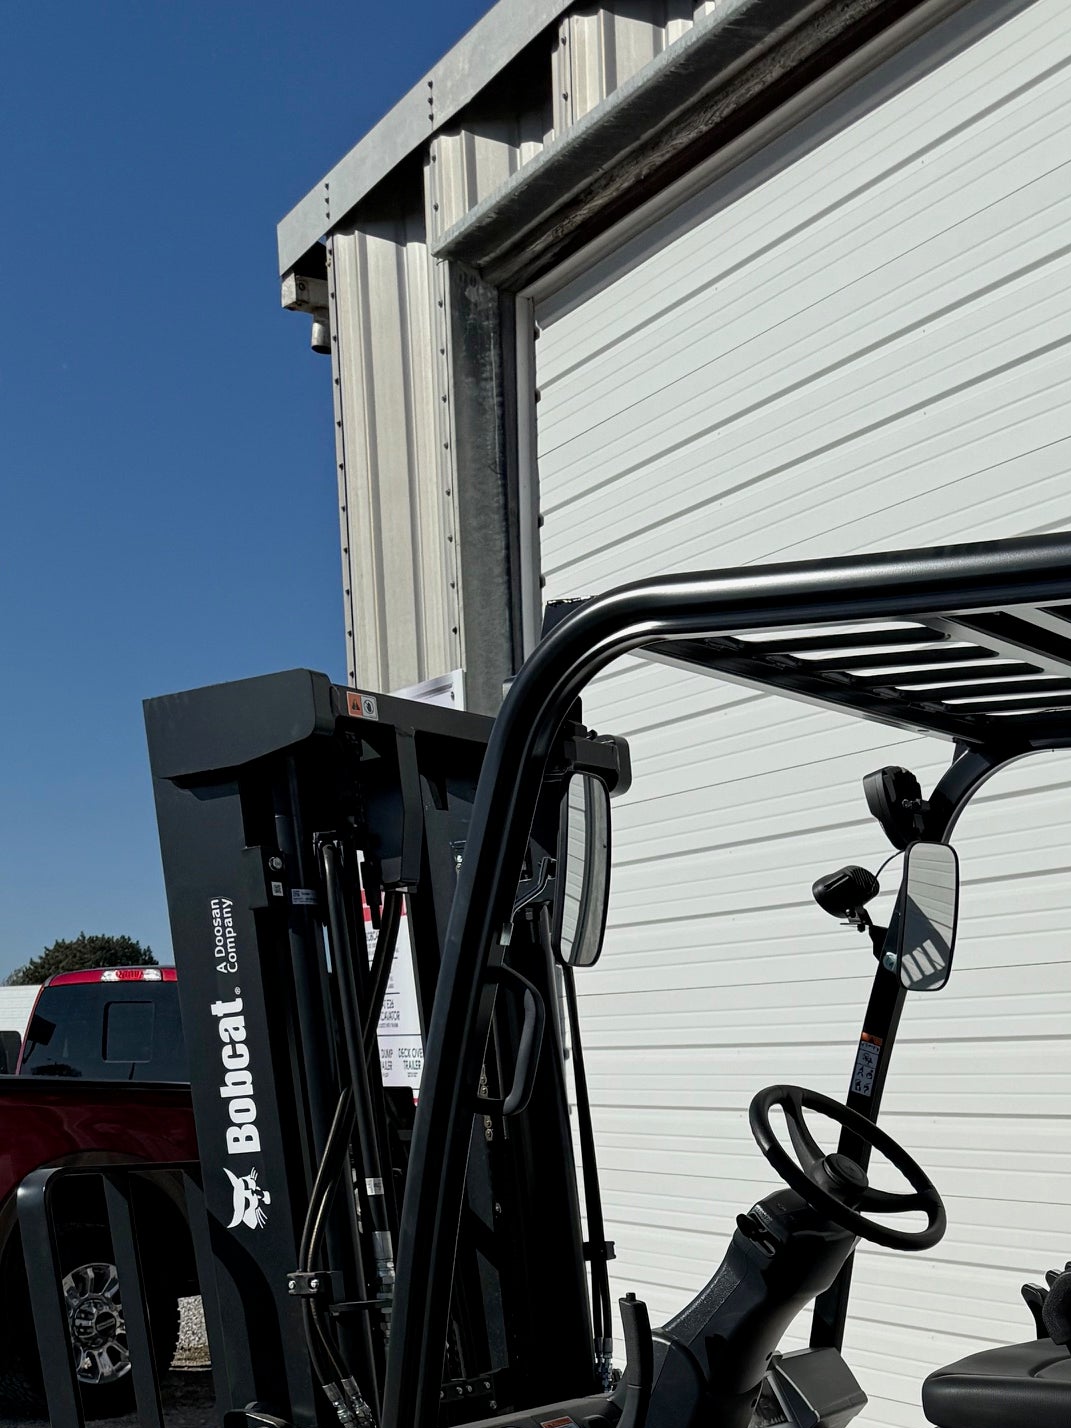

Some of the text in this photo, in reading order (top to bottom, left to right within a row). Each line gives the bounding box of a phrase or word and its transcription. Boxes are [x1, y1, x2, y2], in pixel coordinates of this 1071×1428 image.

[211, 899, 228, 973] A Doosan
[221, 898, 236, 973] Company
[211, 997, 261, 1155] Bobcat
[411, 1047, 424, 1059] OVE
